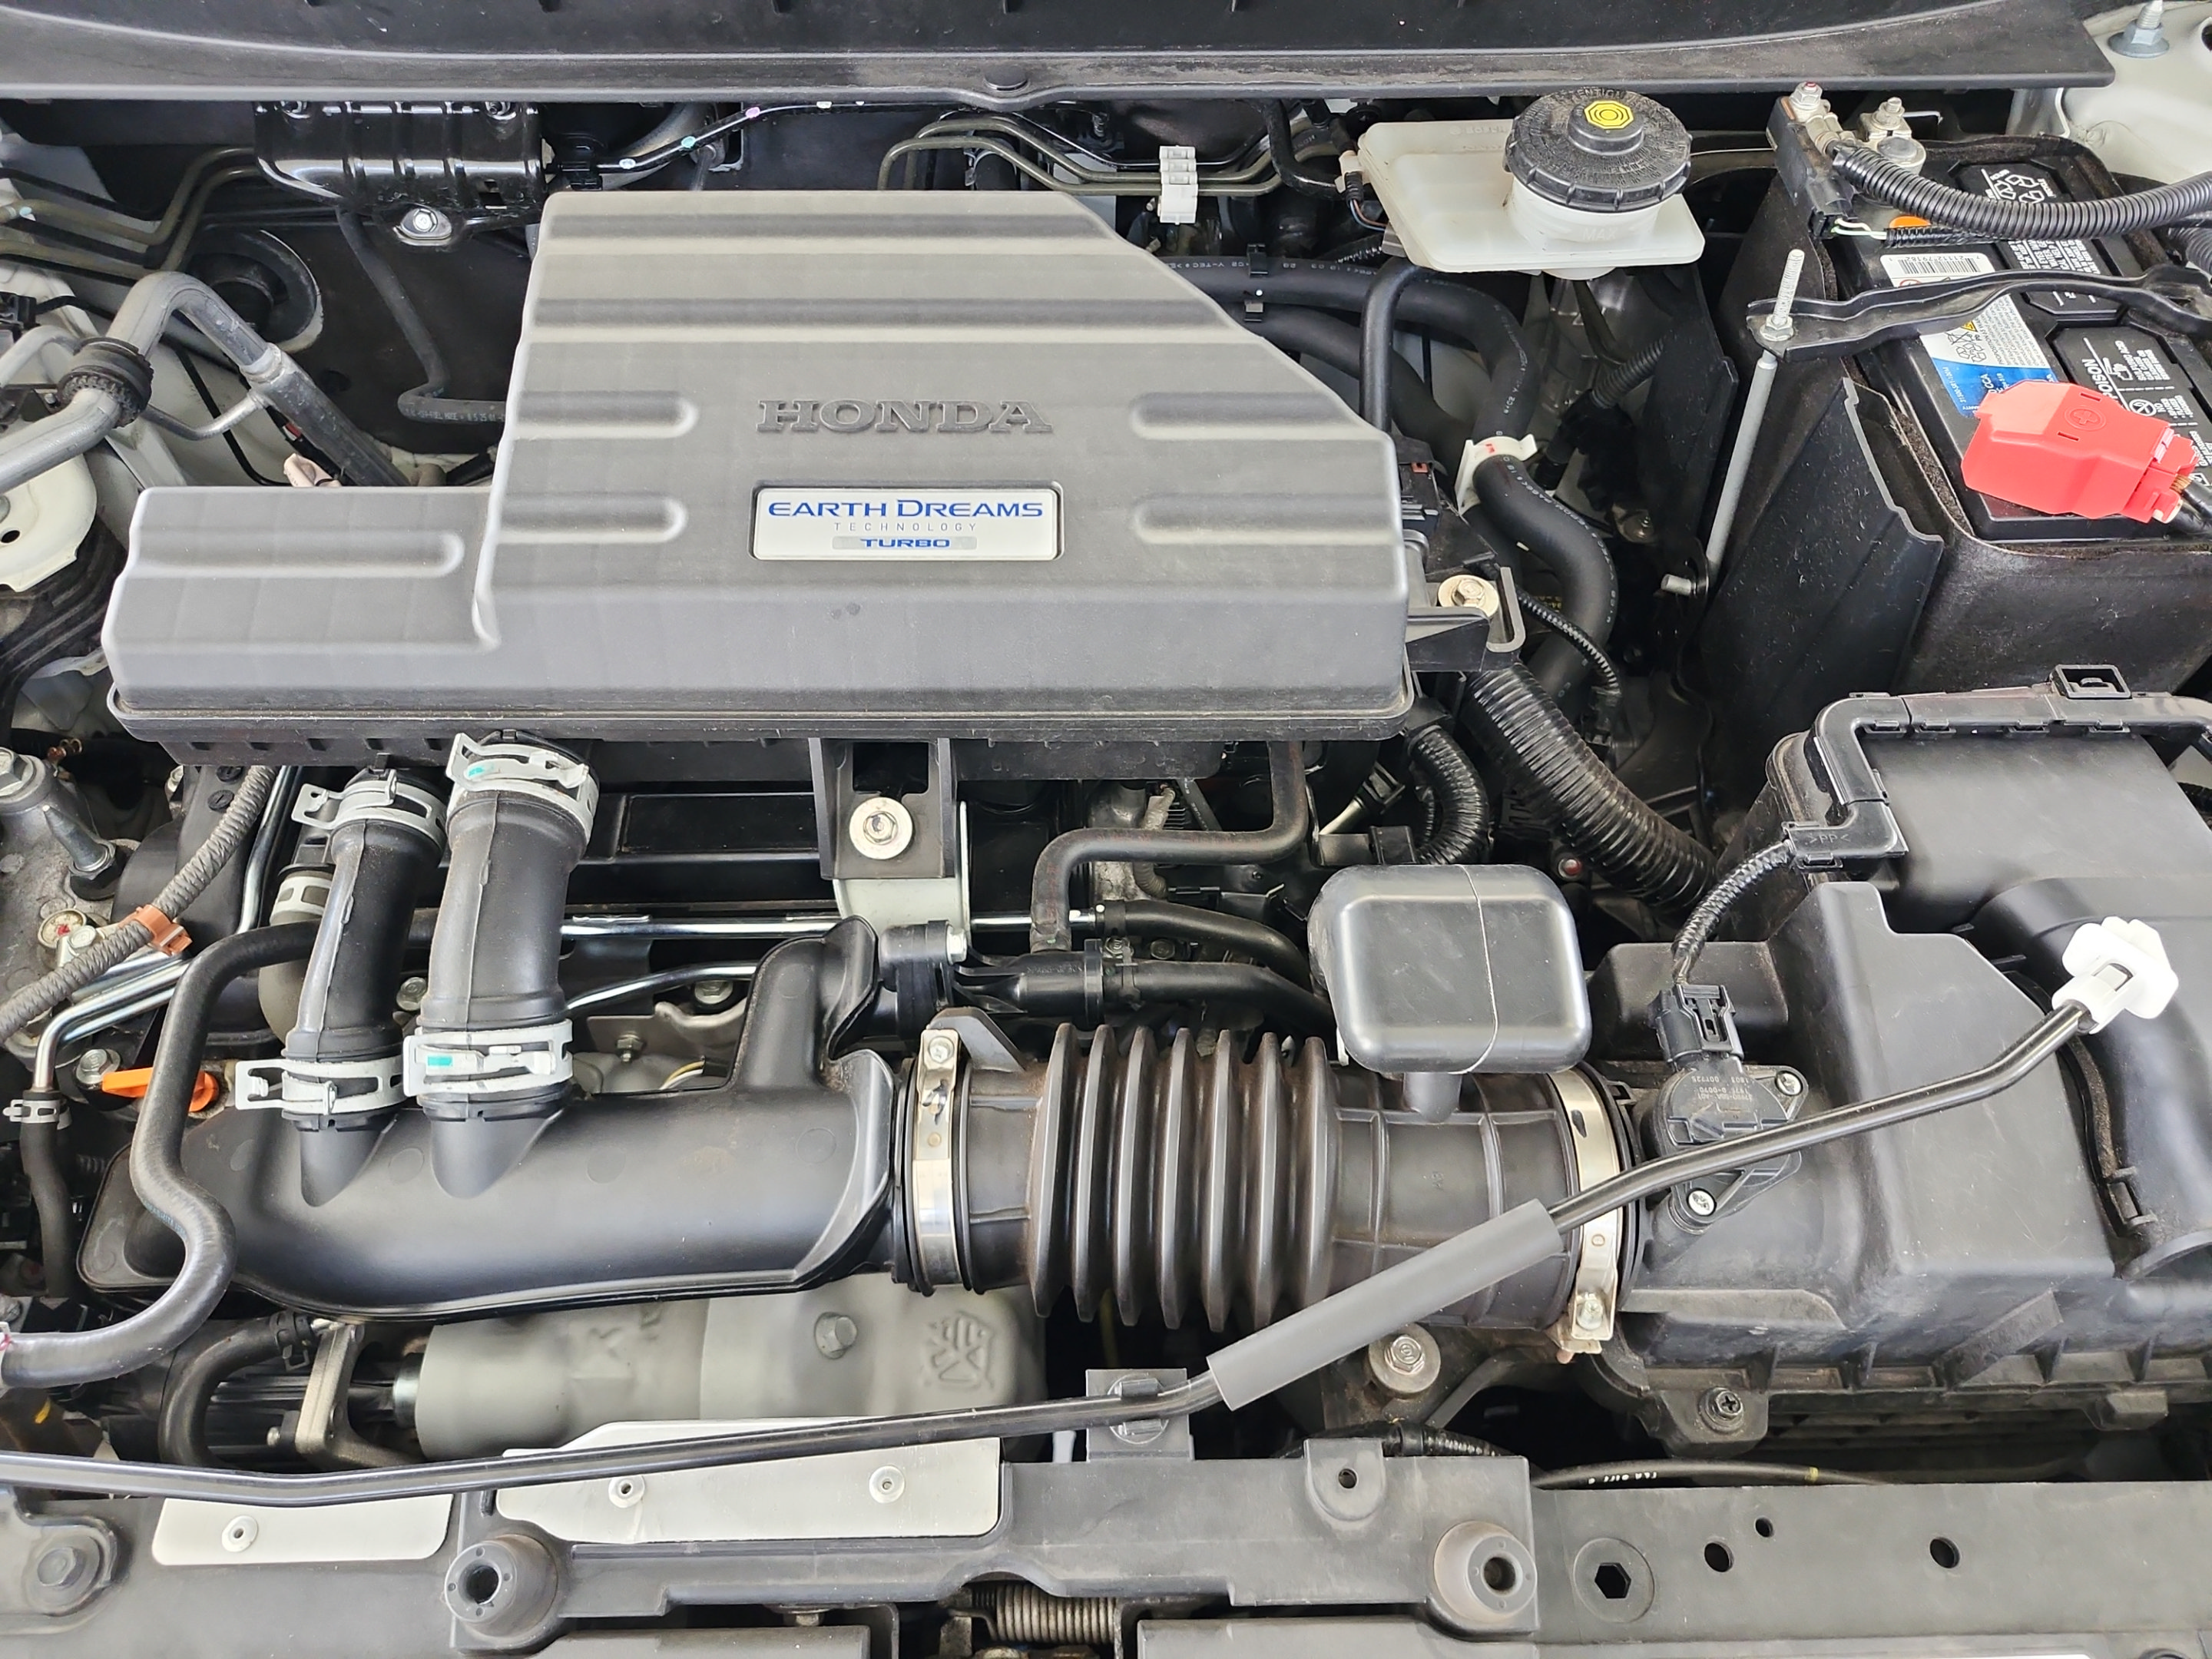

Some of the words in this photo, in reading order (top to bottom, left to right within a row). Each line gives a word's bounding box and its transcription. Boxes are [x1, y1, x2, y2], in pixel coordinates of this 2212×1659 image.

[1582, 227, 1615, 240] MAX
[2033, 251, 2048, 263] EYES
[2048, 245, 2062, 257] HELP
[1978, 373, 1995, 388] CCA
[2081, 358, 2118, 399] POISON
[2153, 402, 2166, 412] NO
[757, 399, 1053, 433] HONDA
[768, 502, 887, 518] EARTH
[897, 499, 1043, 518] DREAMS
[833, 522, 977, 532] TECHNOLOGY
[861, 538, 950, 548] TURBO
